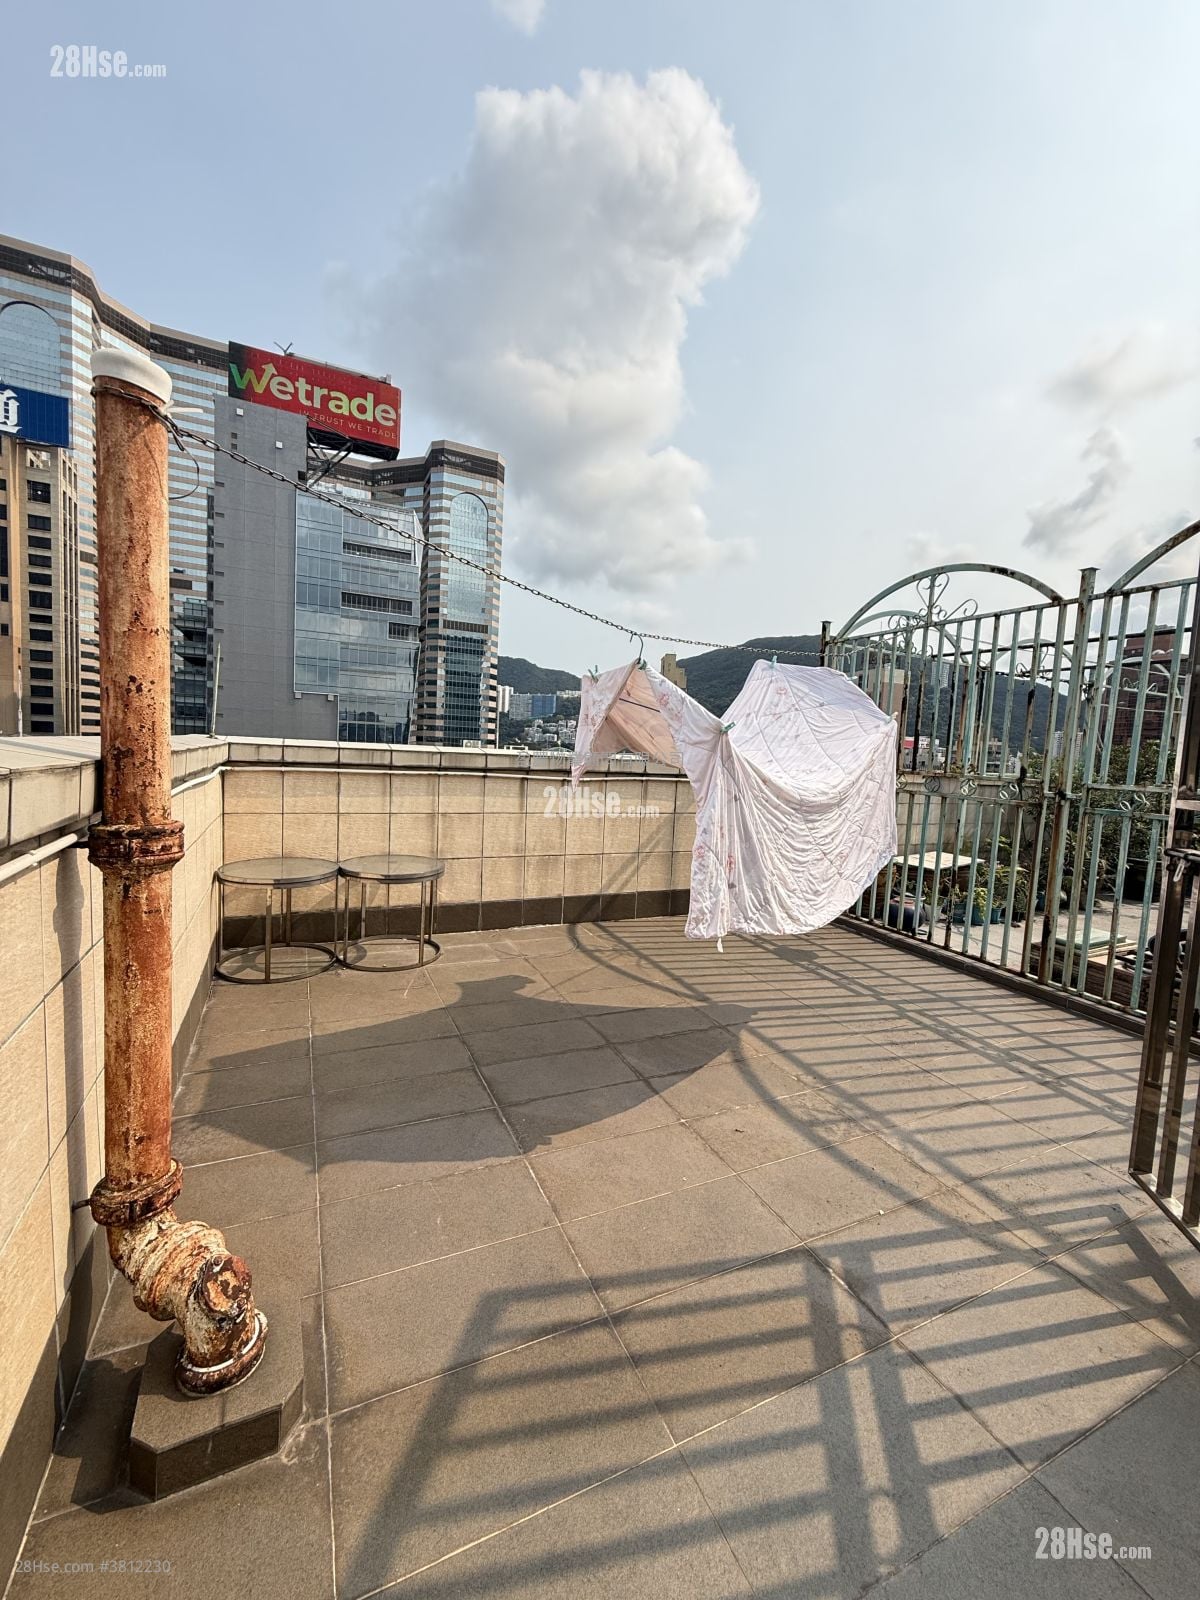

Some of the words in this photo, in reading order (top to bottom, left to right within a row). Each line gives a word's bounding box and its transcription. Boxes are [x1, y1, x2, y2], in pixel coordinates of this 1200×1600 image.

[313, 412, 344, 426] TRUST
[348, 421, 363, 431] WE
[366, 425, 397, 439] TRADE
